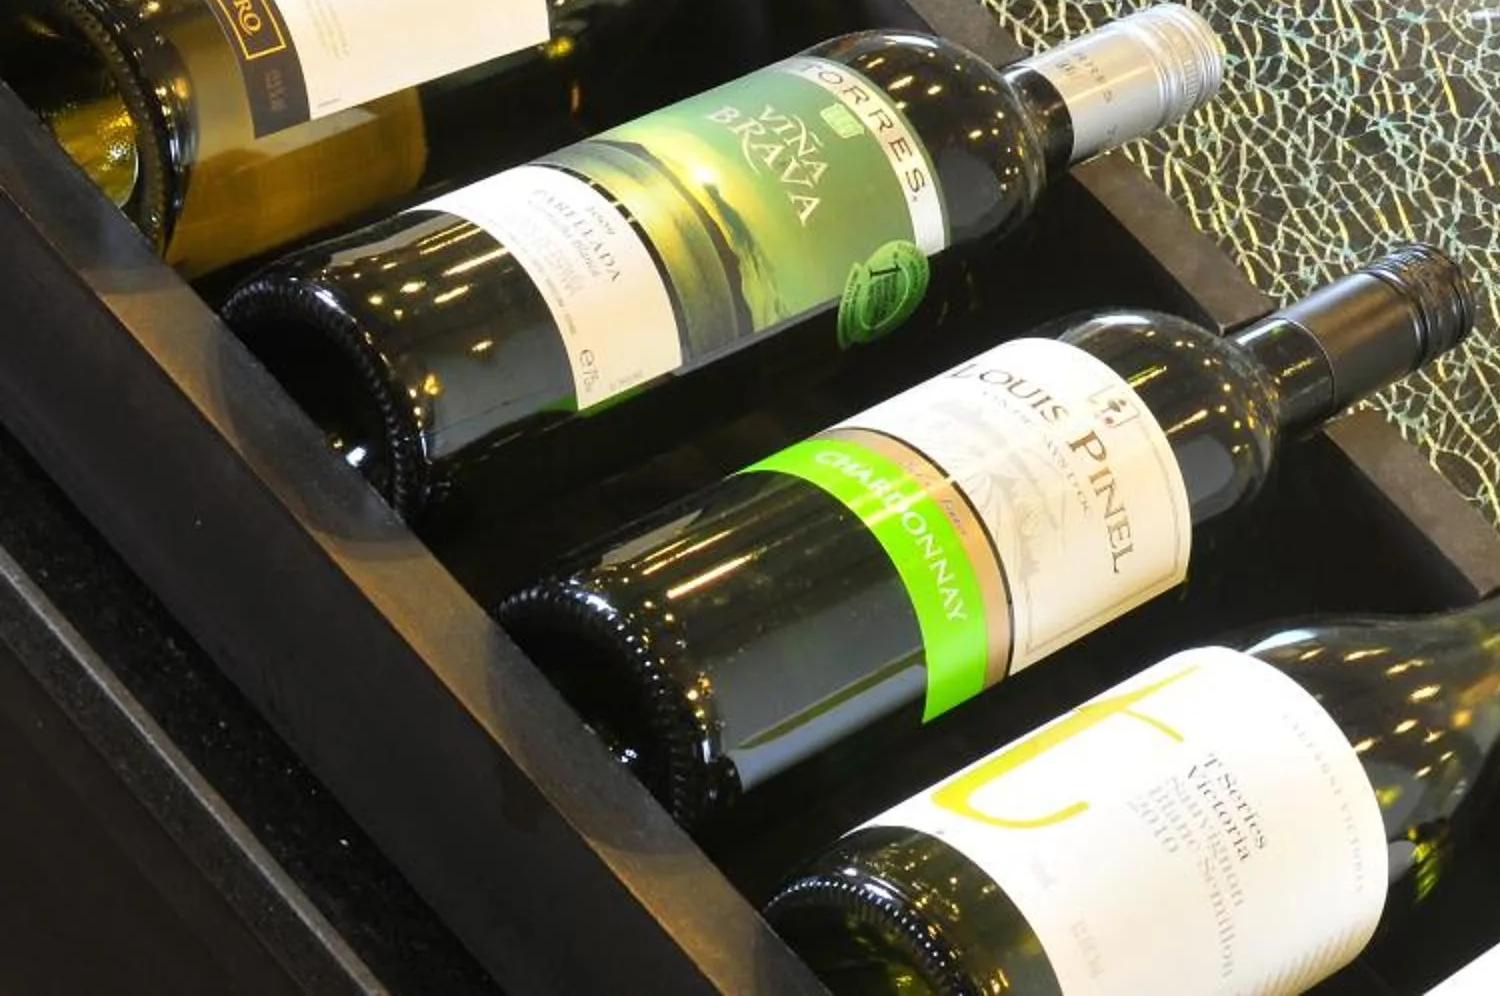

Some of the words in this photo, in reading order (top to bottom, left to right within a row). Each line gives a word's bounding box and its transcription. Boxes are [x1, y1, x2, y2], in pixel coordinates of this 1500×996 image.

[706, 106, 821, 227] BRAVA
[801, 62, 926, 194] TORRES
[951, 363, 1069, 423] LOUIS
[1066, 430, 1134, 574] PINEL
[815, 450, 968, 621] CHARDONNAY
[1187, 764, 1251, 862] Victoria
